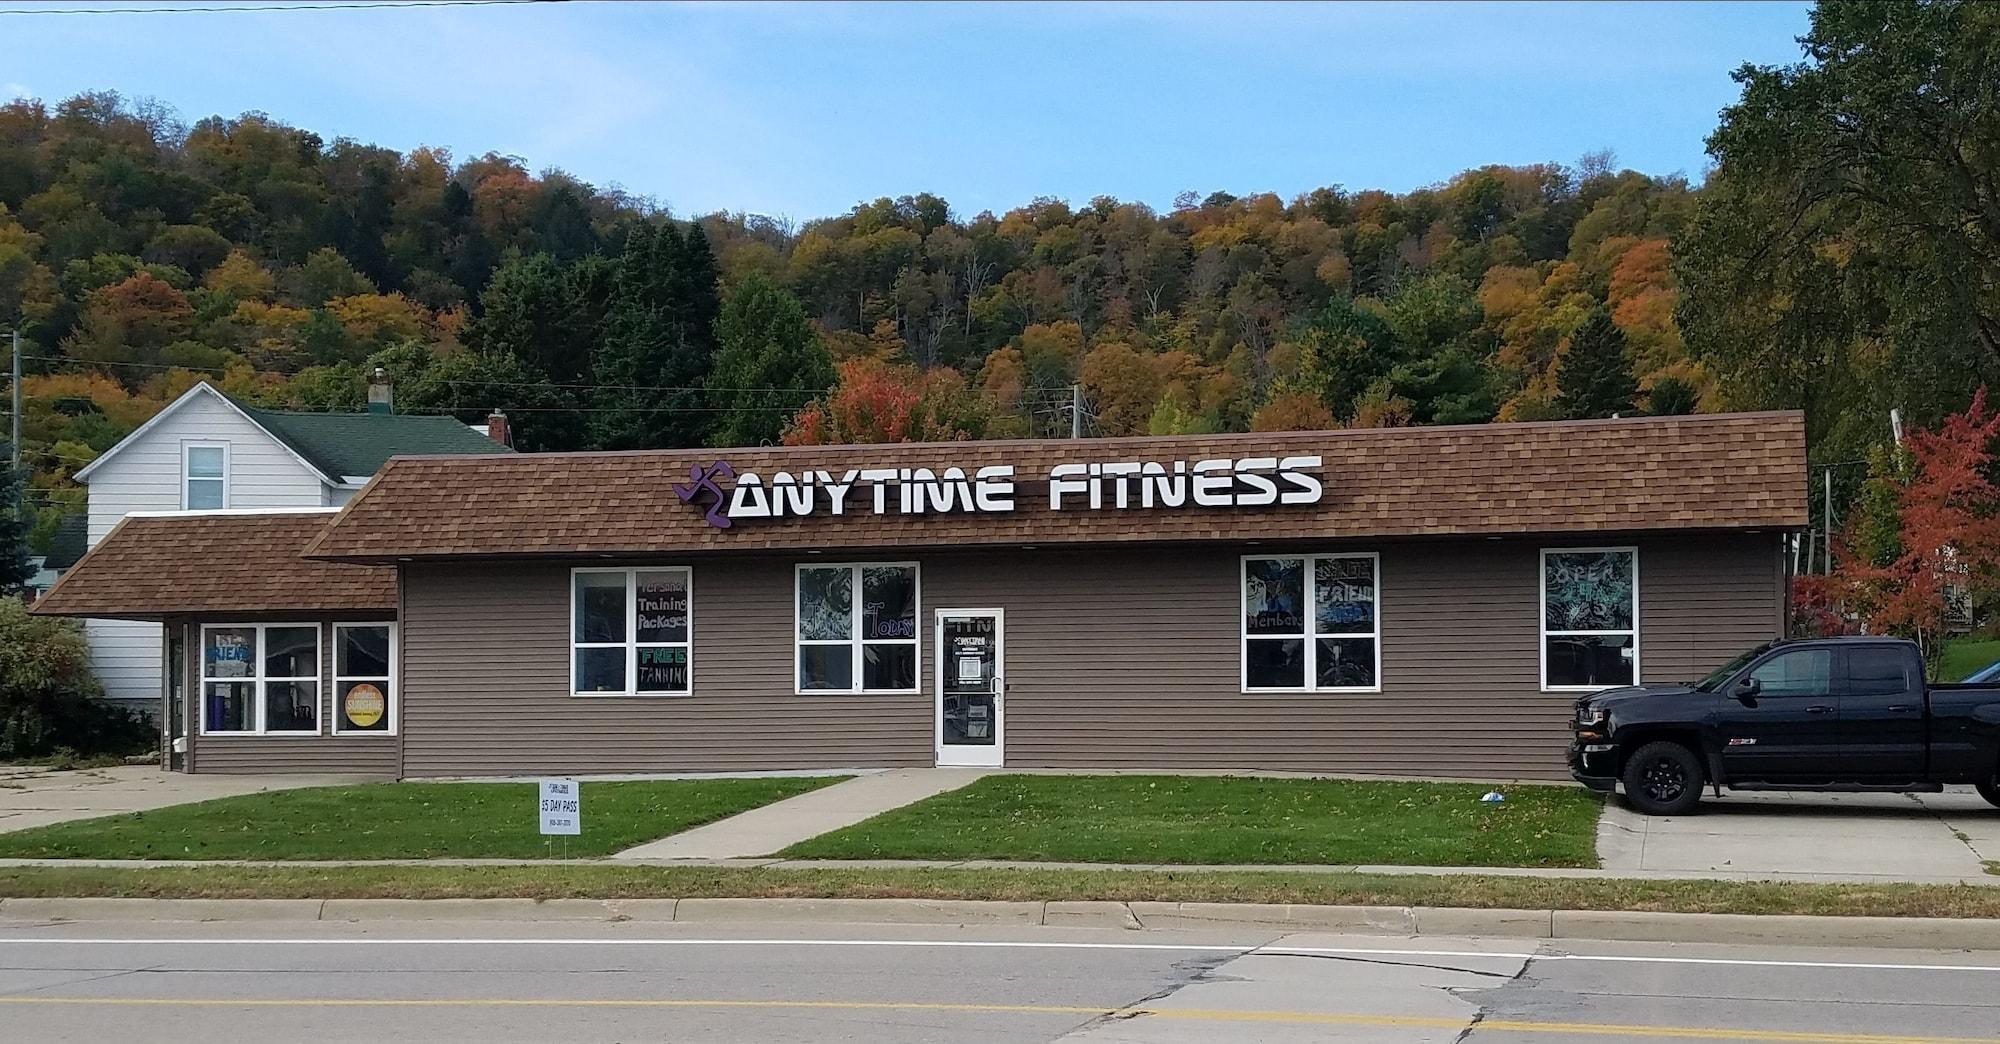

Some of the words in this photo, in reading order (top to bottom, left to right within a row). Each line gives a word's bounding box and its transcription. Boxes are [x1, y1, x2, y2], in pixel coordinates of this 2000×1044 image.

[728, 464, 1015, 518] ANYTIME
[1049, 455, 1324, 511] FITNESS
[637, 597, 688, 613] Training
[637, 613, 688, 630] Packages
[640, 648, 687, 664] FREE
[550, 799, 561, 812] DAY
[562, 800, 577, 813] PASS
